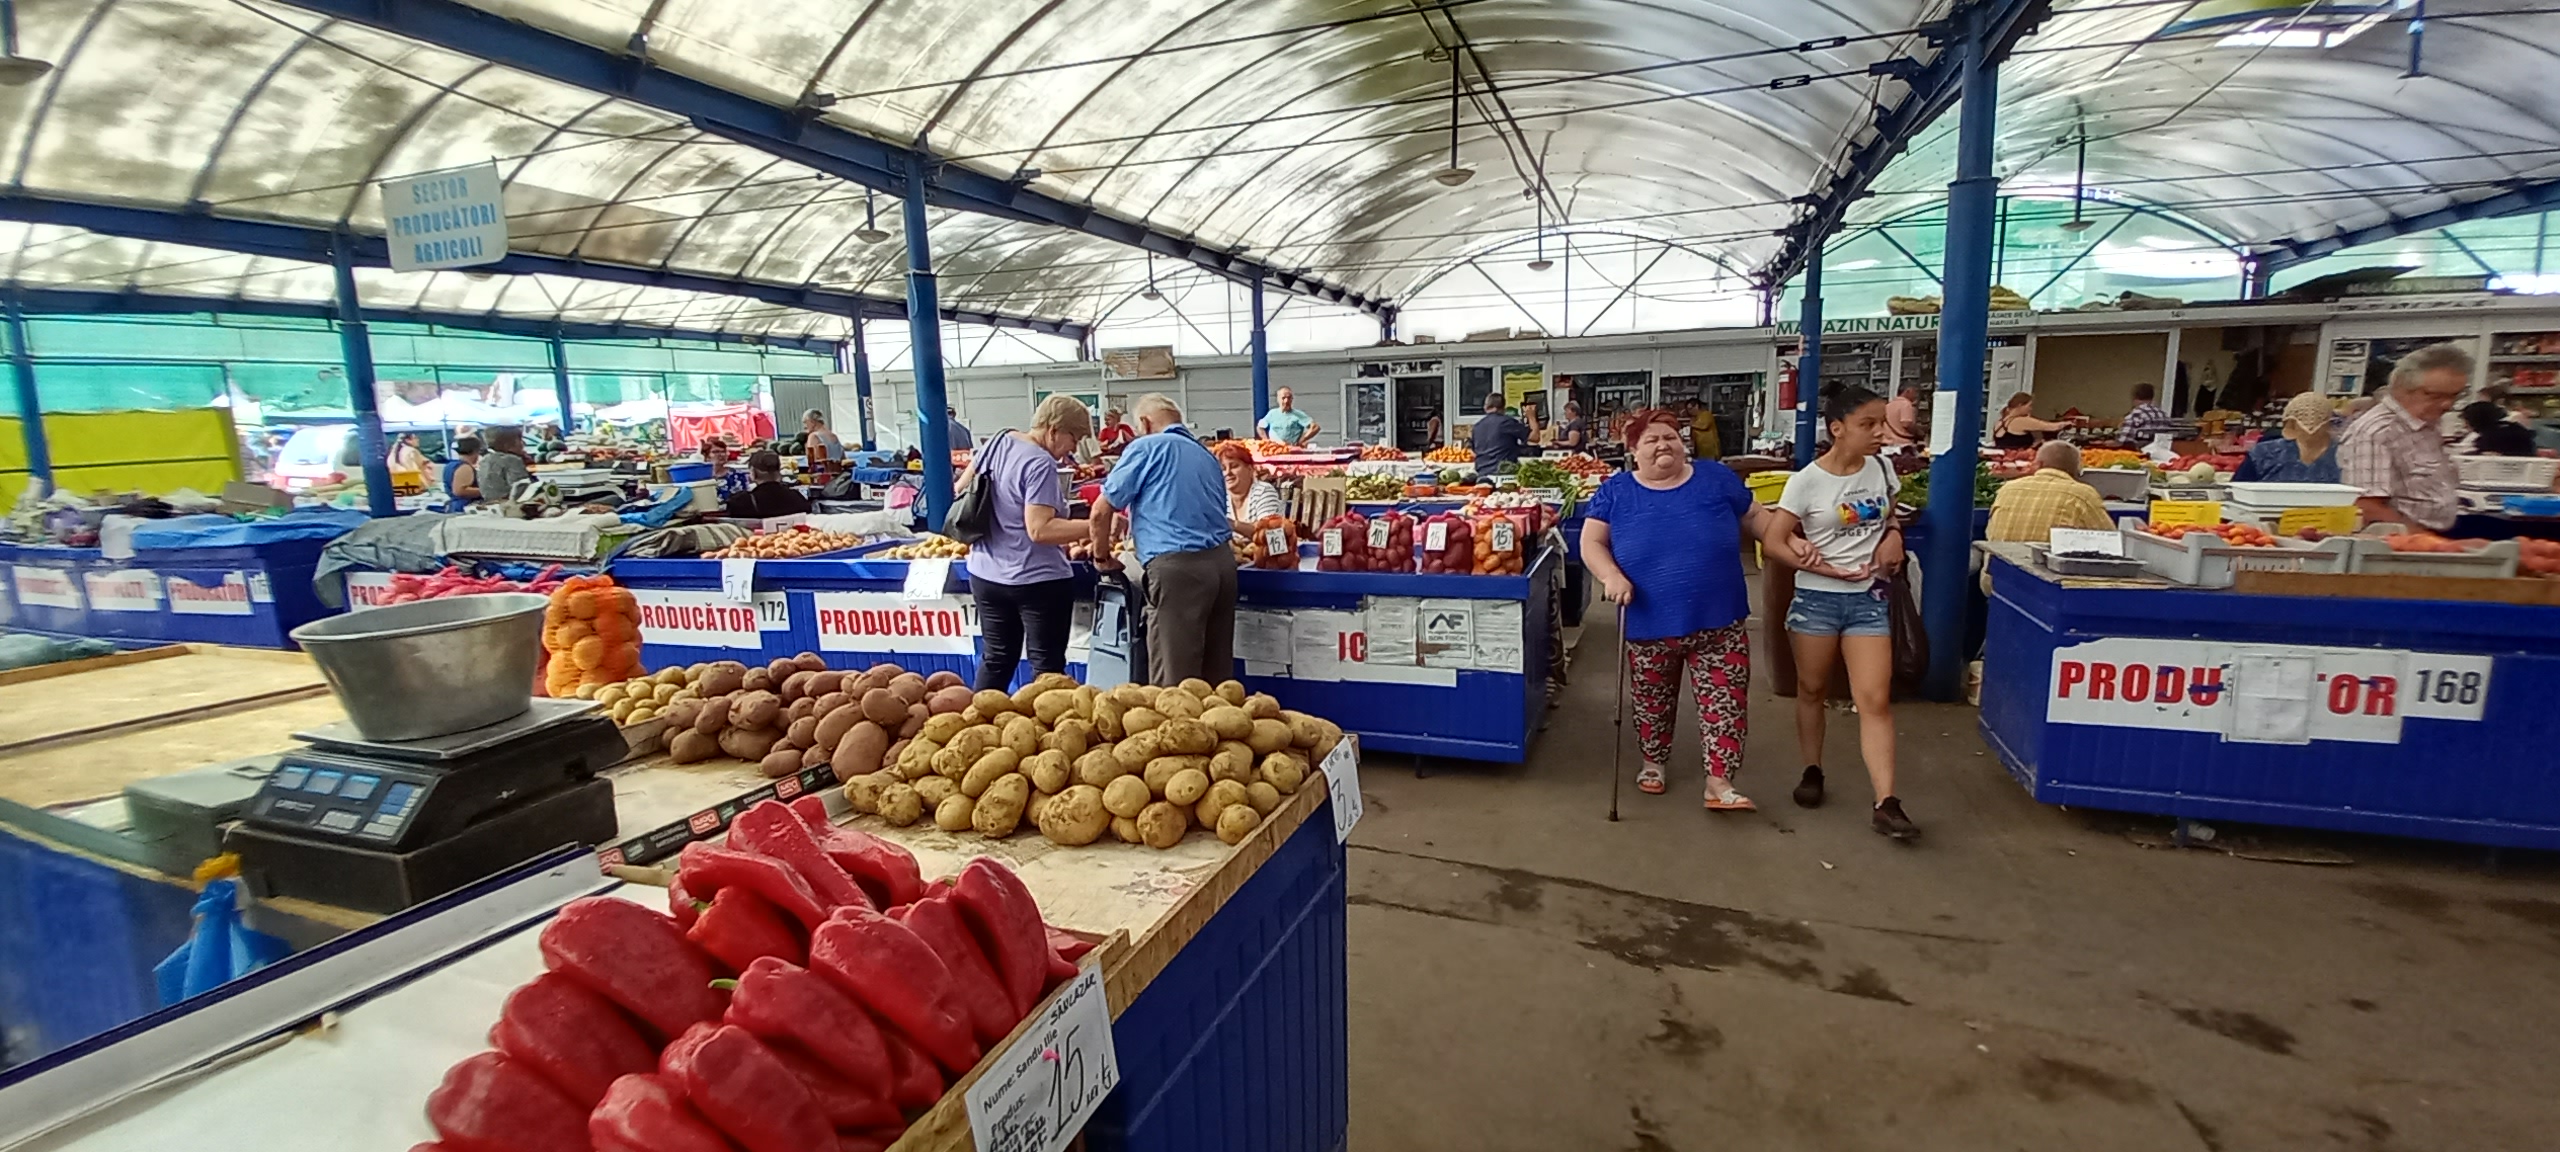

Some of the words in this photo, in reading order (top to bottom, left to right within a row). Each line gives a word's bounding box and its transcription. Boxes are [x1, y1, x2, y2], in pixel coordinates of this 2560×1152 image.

[412, 177, 468, 204] SECTOR
[415, 236, 483, 264] AGRICOLI
[1776, 319, 1870, 335] MAAZIN
[1876, 316, 1940, 331] NATUR
[642, 602, 756, 633] RODUCĂTOR
[759, 601, 786, 622] 172
[961, 603, 979, 626] 17
[2057, 660, 2398, 717] PRODUOR
[2415, 669, 2482, 705] 168
[983, 1074, 1017, 1115] Nume:
[1016, 1044, 1044, 1079] Sandu
[1043, 1028, 1059, 1049] Ilie
[1048, 1024, 1085, 1142] 15
